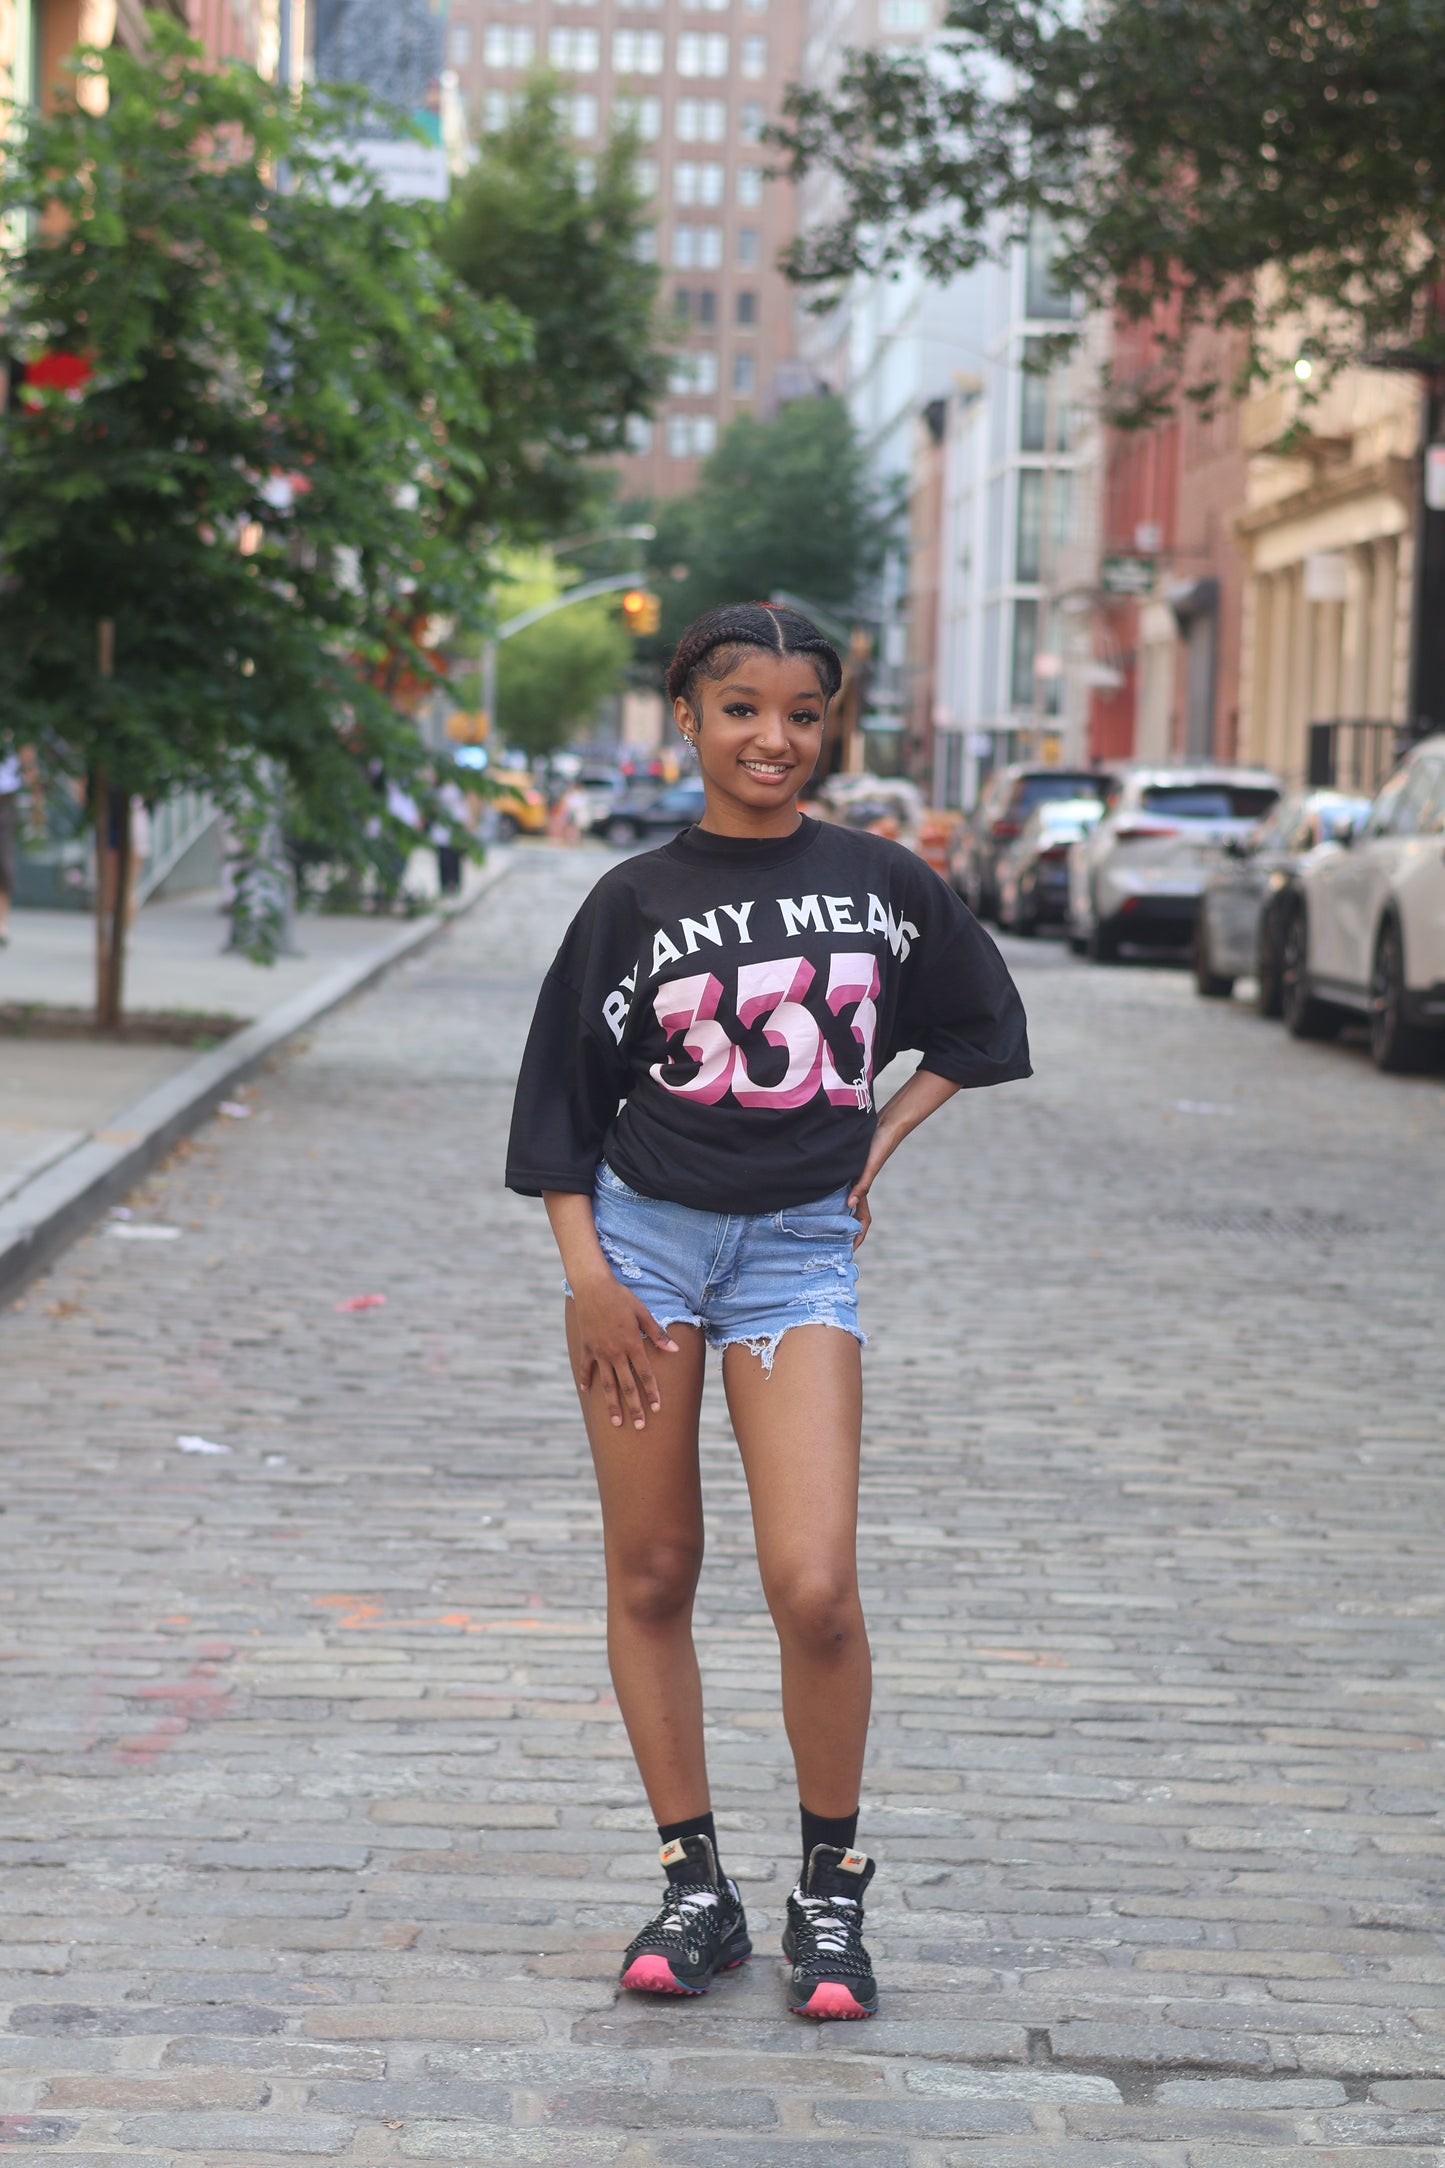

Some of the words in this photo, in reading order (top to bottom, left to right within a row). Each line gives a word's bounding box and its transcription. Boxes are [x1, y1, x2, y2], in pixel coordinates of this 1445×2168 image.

[648, 901, 755, 978] ANY
[776, 892, 921, 964] MEANS
[649, 952, 881, 1110] 333
